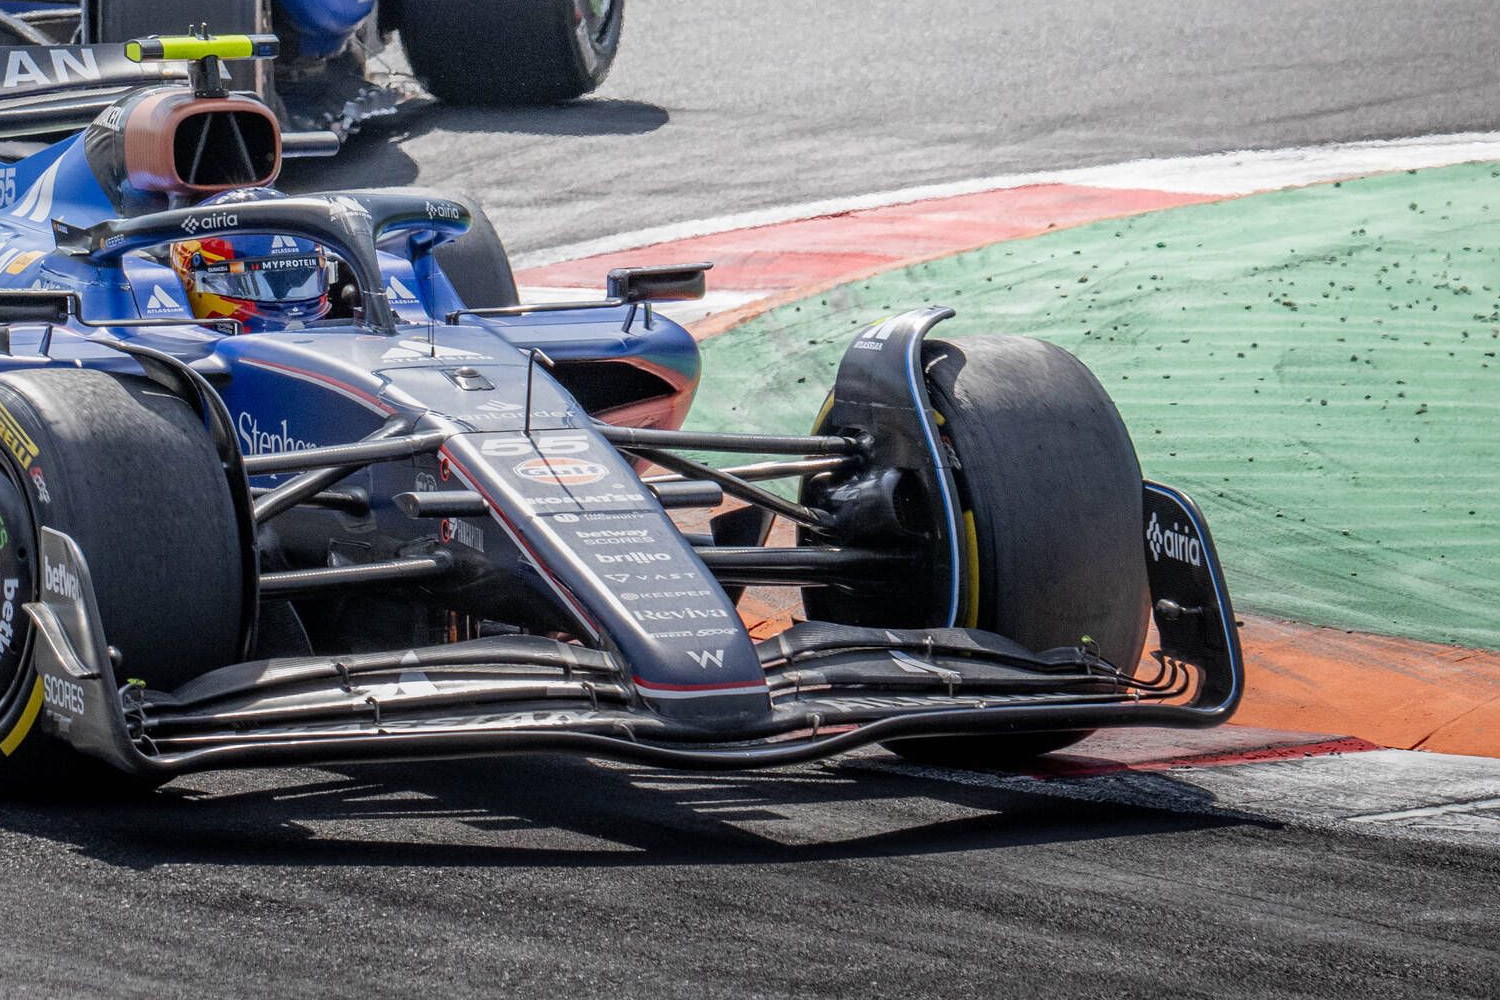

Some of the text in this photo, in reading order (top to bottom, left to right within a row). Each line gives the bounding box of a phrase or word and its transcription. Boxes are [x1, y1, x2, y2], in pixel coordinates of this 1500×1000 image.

[200, 212, 238, 230] airia
[262, 258, 317, 271] MYPROTEIN
[479, 434, 590, 457] 55
[575, 530, 648, 538] betway
[583, 536, 655, 545] SCORES
[1164, 522, 1200, 568] airia
[635, 572, 697, 580] VAST
[640, 590, 711, 599] KEEPER
[633, 607, 728, 621] Reviva
[42, 673, 85, 716] SCORES
